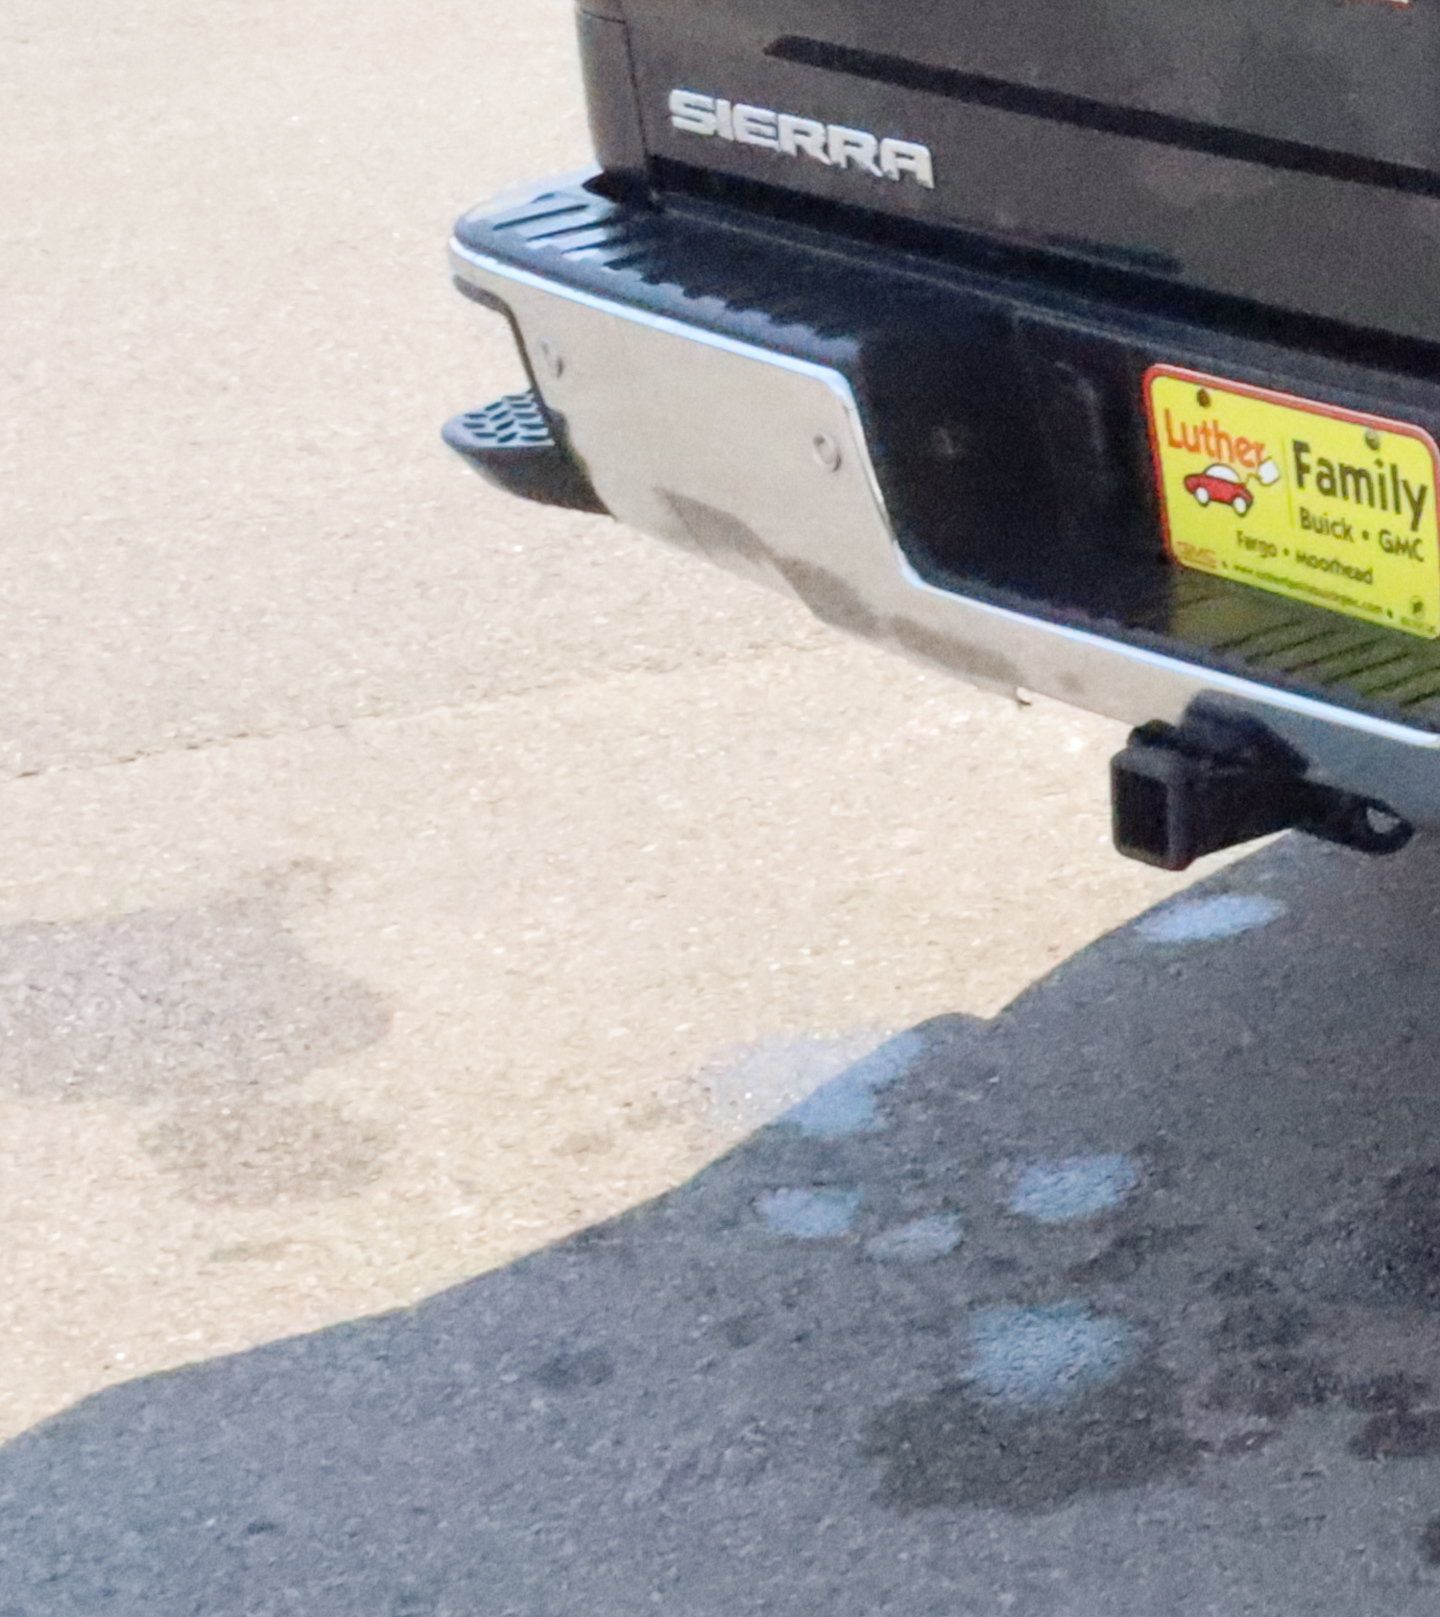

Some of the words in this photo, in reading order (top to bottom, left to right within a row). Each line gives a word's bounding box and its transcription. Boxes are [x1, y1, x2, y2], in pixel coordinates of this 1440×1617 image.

[668, 88, 935, 189] SIERRA
[1164, 407, 1266, 469] Luther
[1292, 439, 1428, 533] Family
[1236, 529, 1279, 560] Fargo
[1298, 506, 1355, 544] Buick
[1377, 528, 1425, 564] GMC
